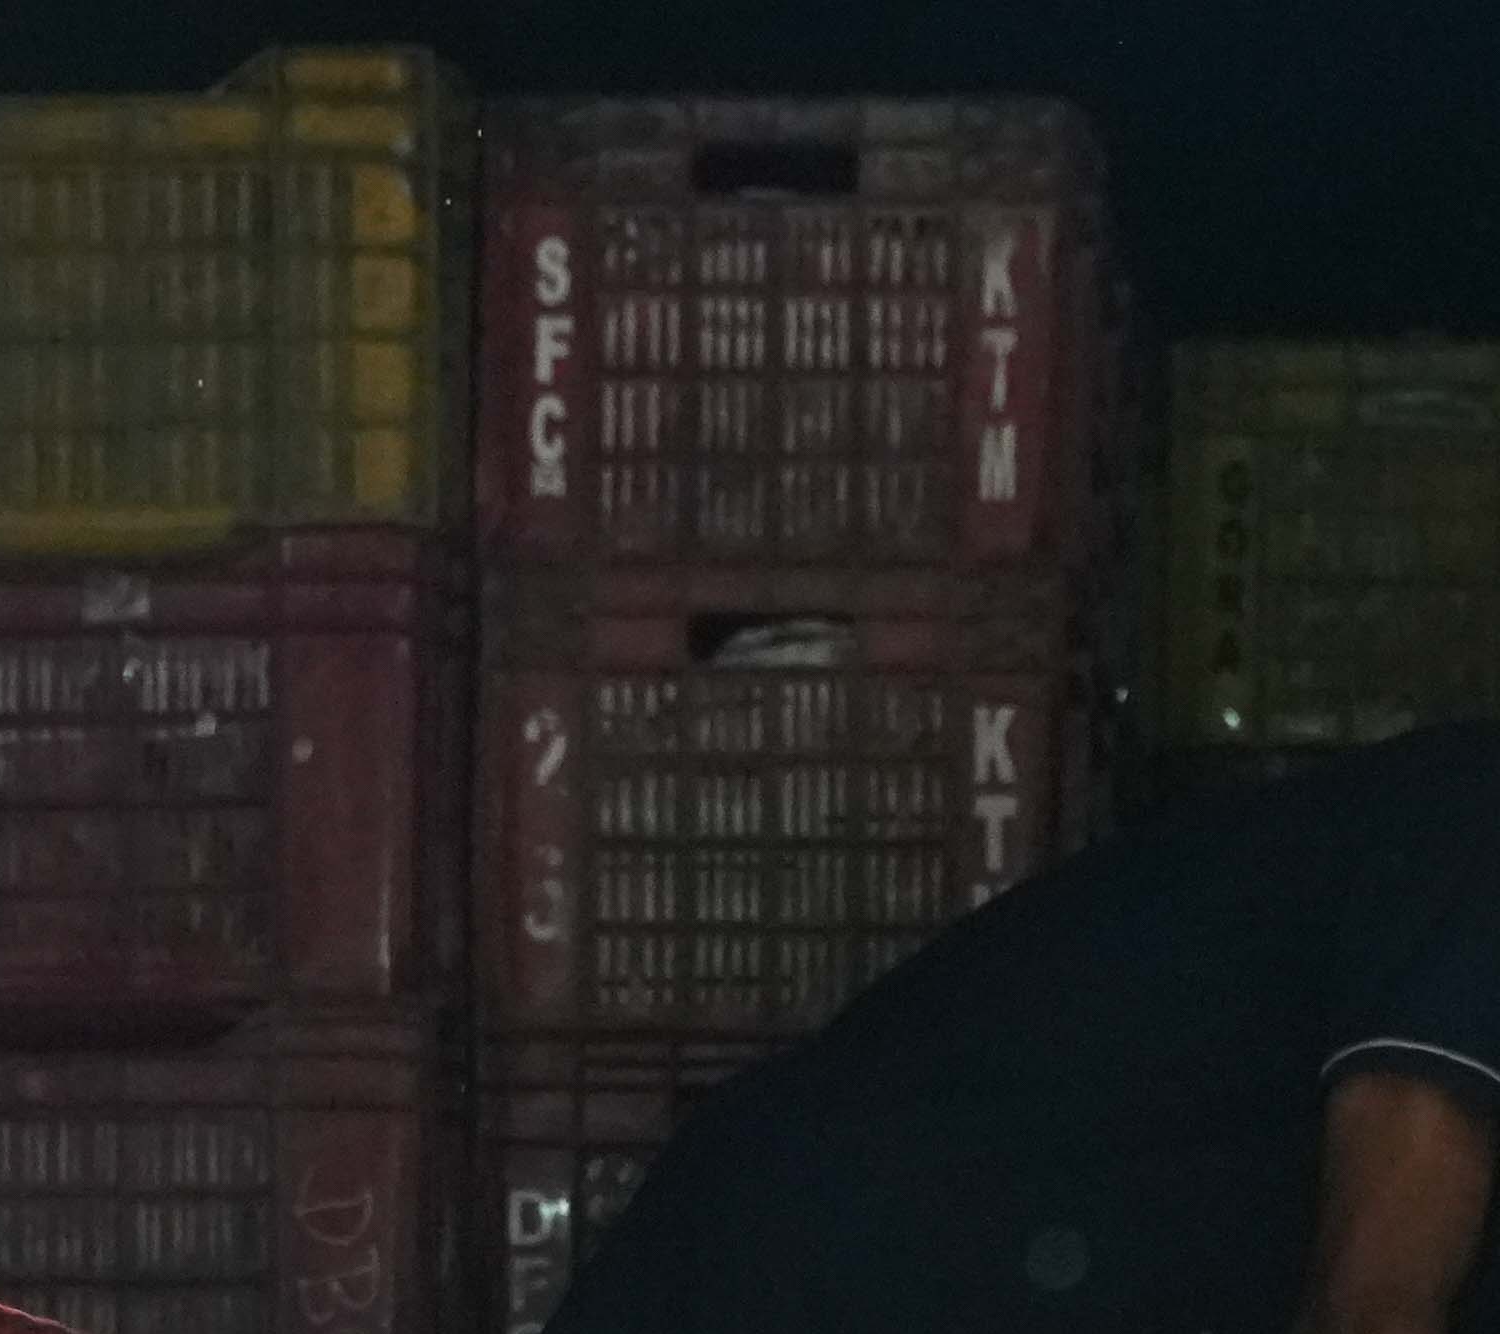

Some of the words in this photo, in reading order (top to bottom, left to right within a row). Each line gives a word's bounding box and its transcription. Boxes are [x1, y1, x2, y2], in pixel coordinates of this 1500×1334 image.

[530, 236, 575, 465] SFC
[979, 230, 1018, 500] KTM
[972, 705, 1019, 912] KT
